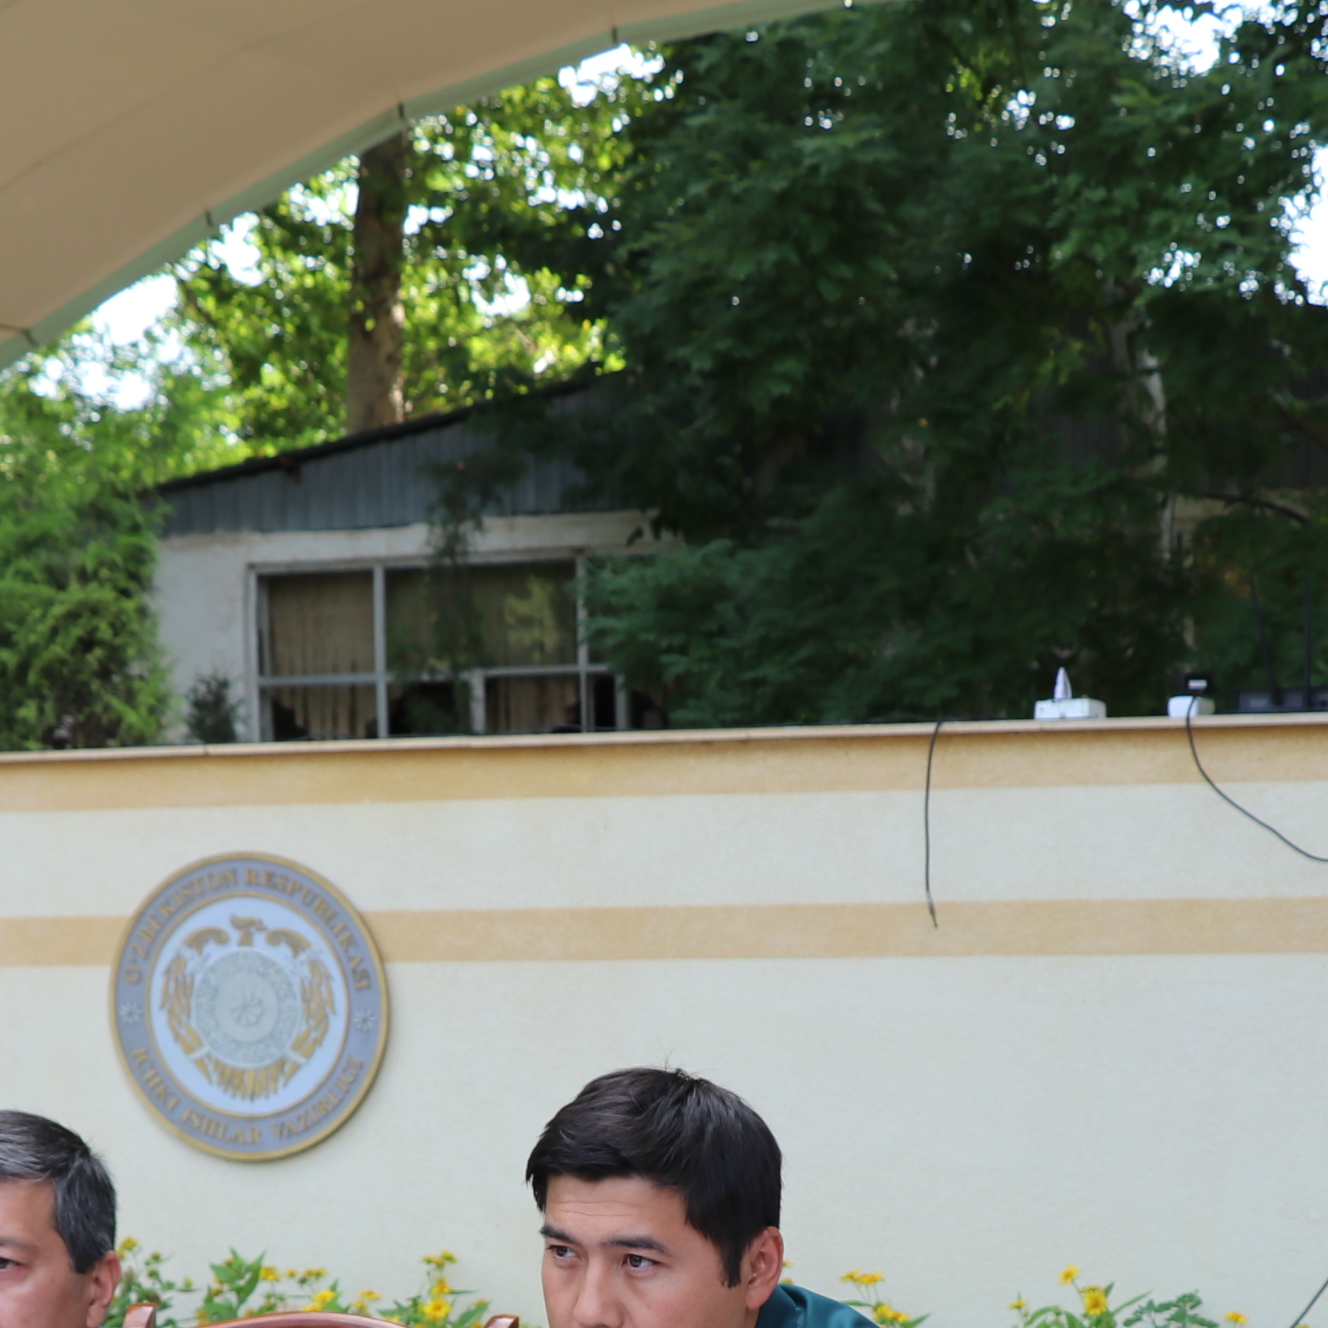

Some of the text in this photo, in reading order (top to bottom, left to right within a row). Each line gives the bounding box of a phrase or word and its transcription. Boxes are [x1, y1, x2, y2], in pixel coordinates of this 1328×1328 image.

[244, 866, 372, 992] RESPUBLIKASI
[131, 1046, 366, 1144] ICHKI ISHLAR VAZIRLIGI
